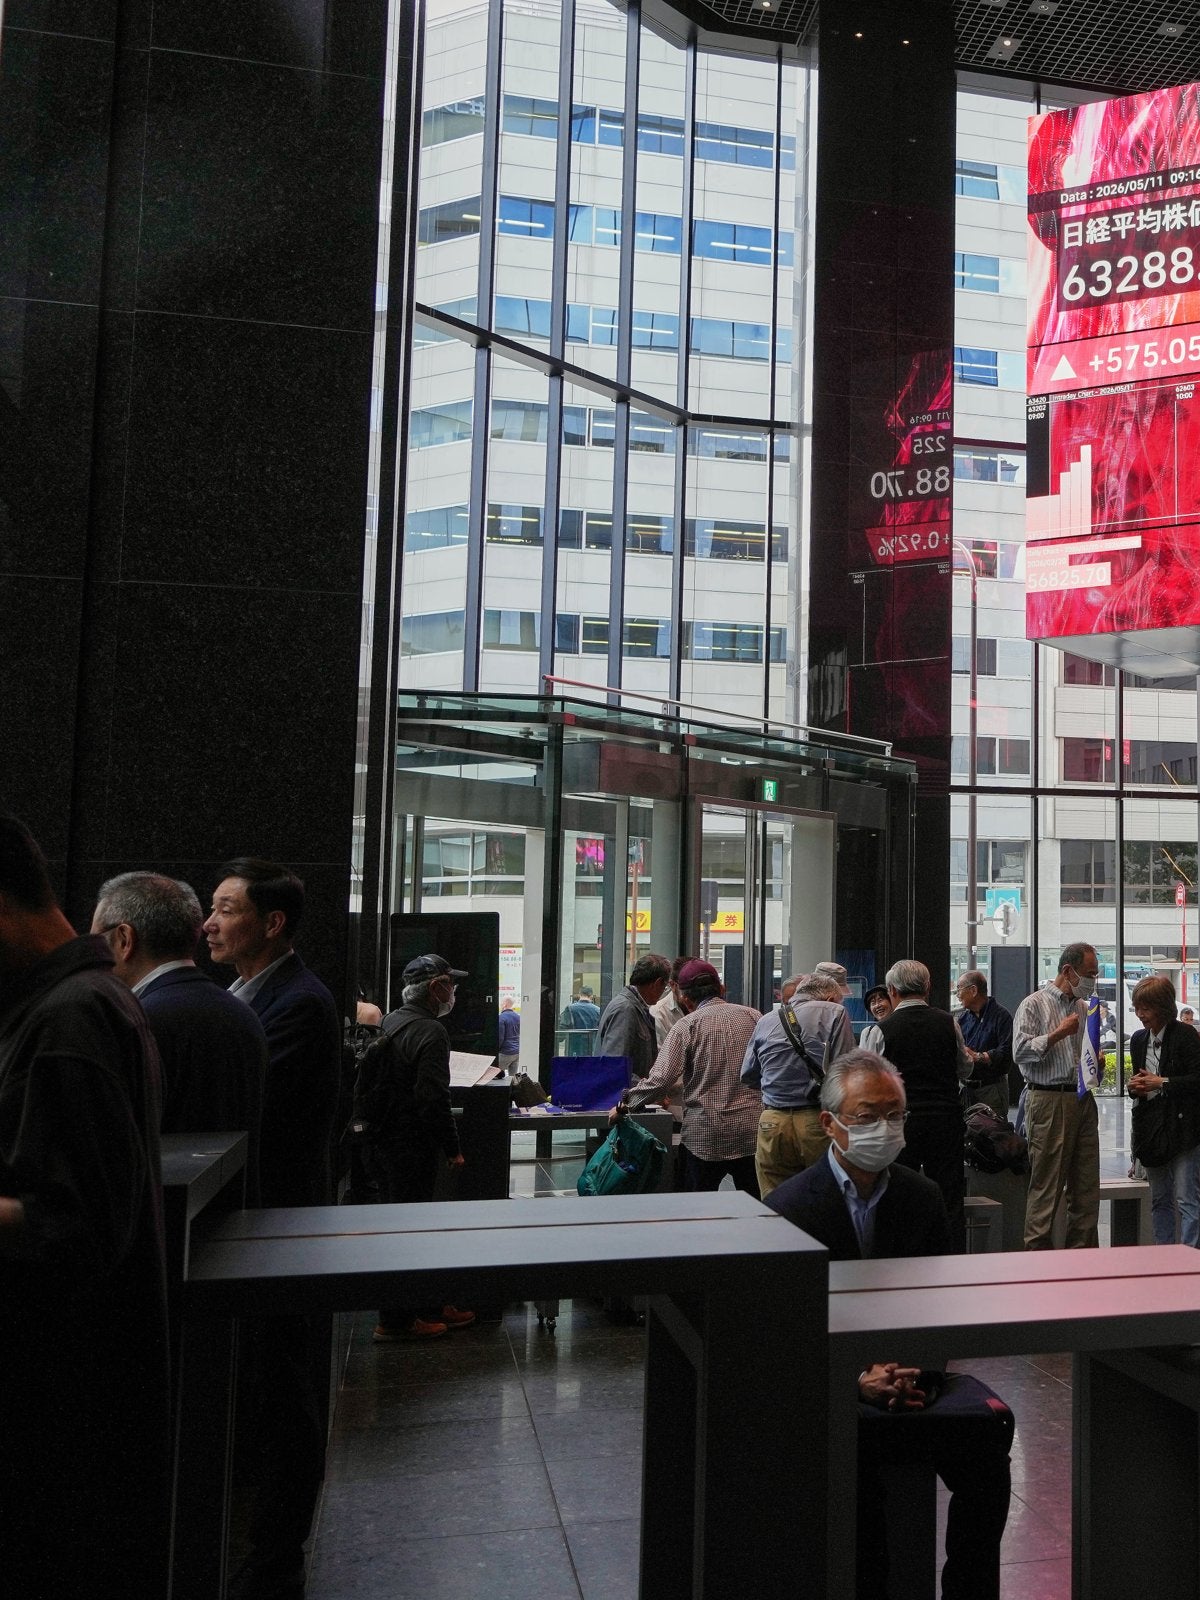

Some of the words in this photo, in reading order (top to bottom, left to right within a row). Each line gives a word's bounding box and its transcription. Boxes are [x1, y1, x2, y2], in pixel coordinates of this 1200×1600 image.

[1060, 192, 1087, 204] Data
[1096, 175, 1163, 198] 2026/05/11
[1077, 390, 1094, 399] Chart
[1176, 392, 1193, 400] 10:00
[1028, 404, 1046, 413] 63202
[1028, 412, 1045, 420] 09:00
[1027, 566, 1107, 589] 56825.70
